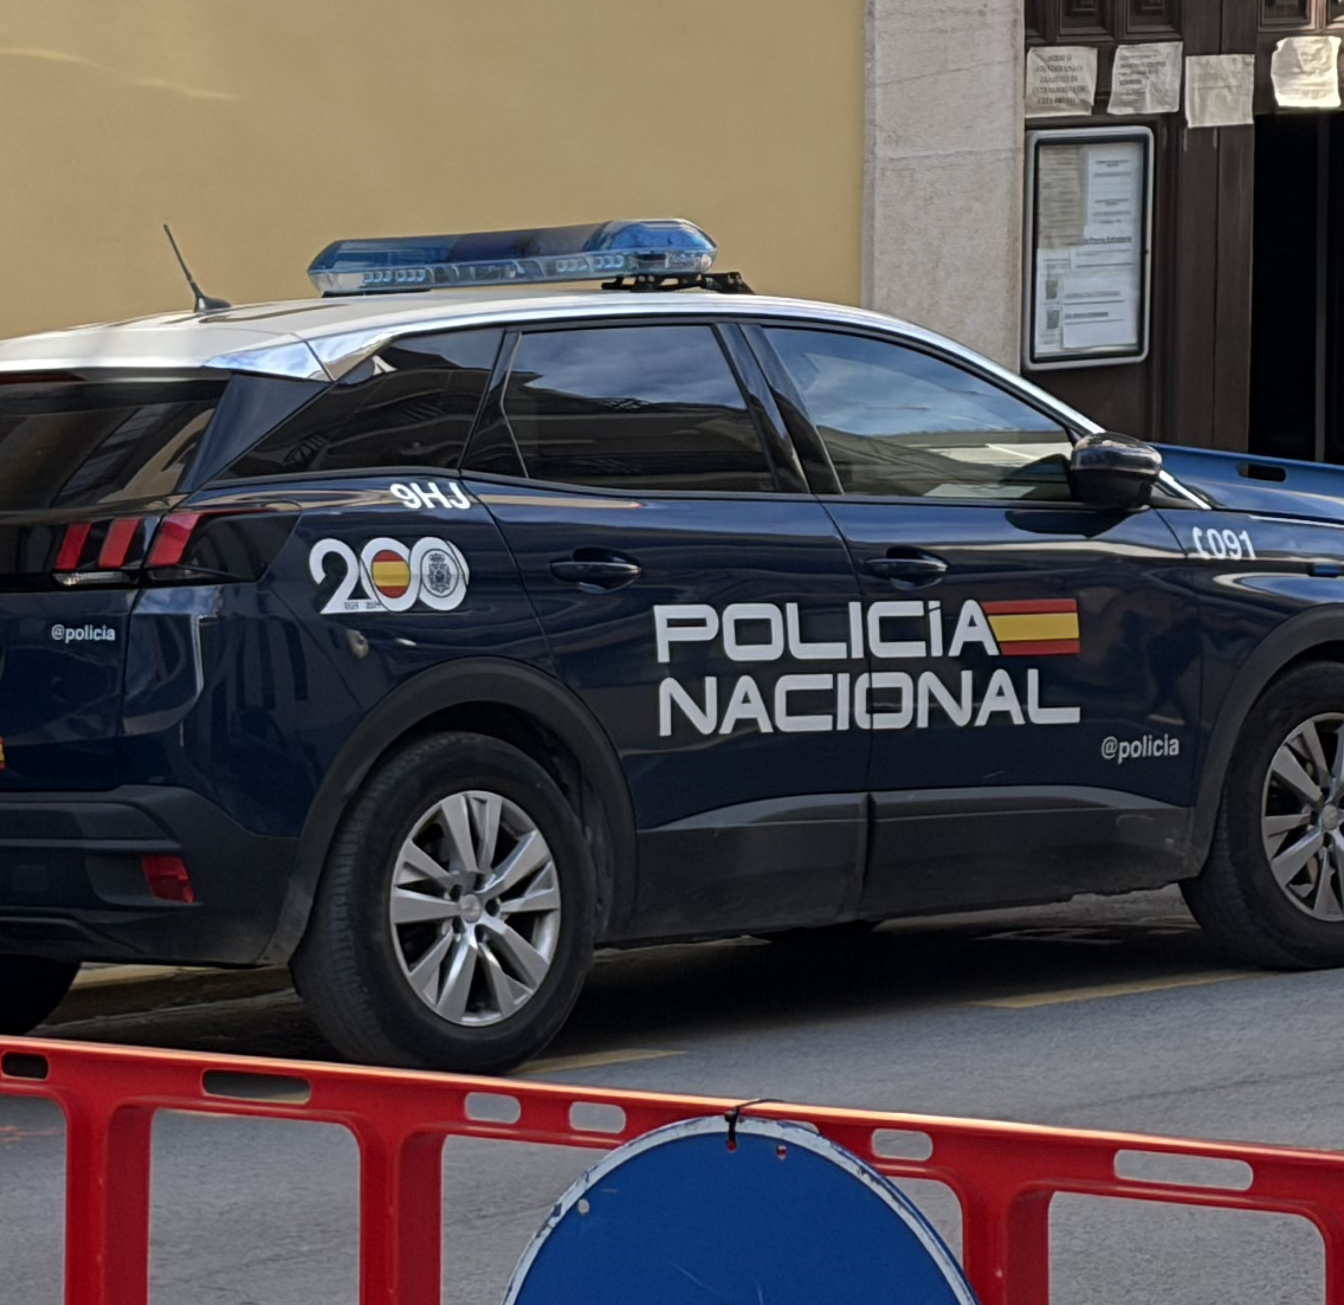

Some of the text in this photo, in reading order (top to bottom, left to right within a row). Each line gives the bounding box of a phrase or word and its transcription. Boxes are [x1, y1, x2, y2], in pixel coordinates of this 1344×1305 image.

[389, 482, 471, 509] 9HJ
[1206, 528, 1257, 561] 091
[309, 536, 470, 614] 200
[51, 624, 116, 644] @policia
[659, 668, 1082, 737] NACIONAL
[1101, 733, 1180, 765] @policia
